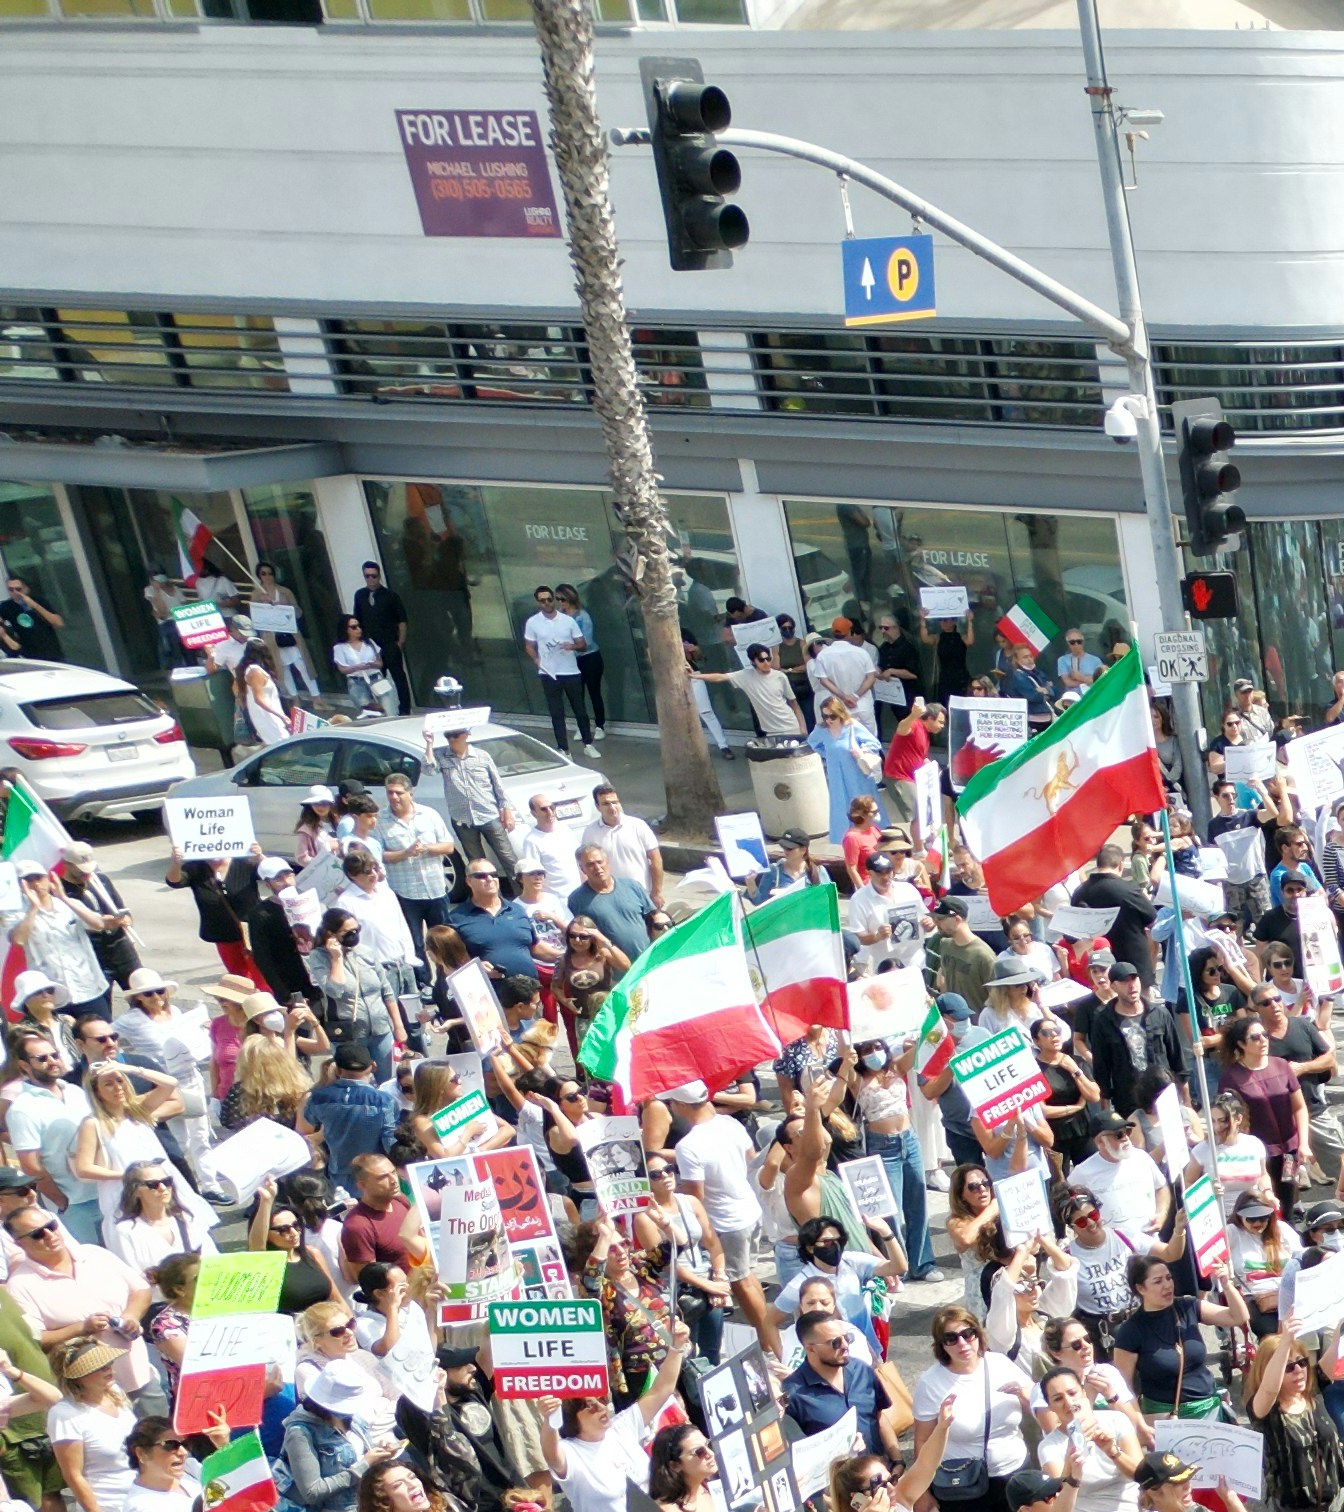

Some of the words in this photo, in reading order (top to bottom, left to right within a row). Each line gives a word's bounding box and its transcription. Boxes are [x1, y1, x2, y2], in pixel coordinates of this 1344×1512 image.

[402, 114, 454, 146] FOR
[456, 114, 536, 147] LEASE
[428, 161, 475, 177] MICHAEL
[479, 161, 528, 178] LUSHING
[432, 179, 464, 202] (310)
[464, 179, 533, 199] 505-0565
[897, 259, 912, 290] P
[524, 525, 551, 540] FOR
[553, 526, 589, 541] LEASE
[922, 550, 948, 566] FOR
[950, 551, 990, 568] LEASE
[174, 602, 217, 620] WOMEN
[190, 619, 211, 632] LIFE
[186, 631, 228, 646] FREEDOM
[1158, 635, 1198, 645] DIAGONAL
[1160, 644, 1200, 654] CROSSING
[1159, 659, 1180, 678] OK
[184, 807, 234, 821] Woman
[199, 823, 225, 837] Life
[184, 840, 244, 855] Freedom
[955, 1037, 1020, 1075] WOMEN
[983, 1062, 1020, 1091] LIFE
[981, 1080, 1048, 1123] FREEDOM
[435, 1101, 487, 1131] WOMEN
[448, 1216, 475, 1235] The
[1084, 1260, 1123, 1281] IRAN
[1088, 1276, 1127, 1300] IRAN
[494, 1307, 596, 1328] WOMEN
[199, 1323, 248, 1357] LIFE
[523, 1340, 575, 1359] LIFE
[501, 1373, 602, 1393] FREEDOM
